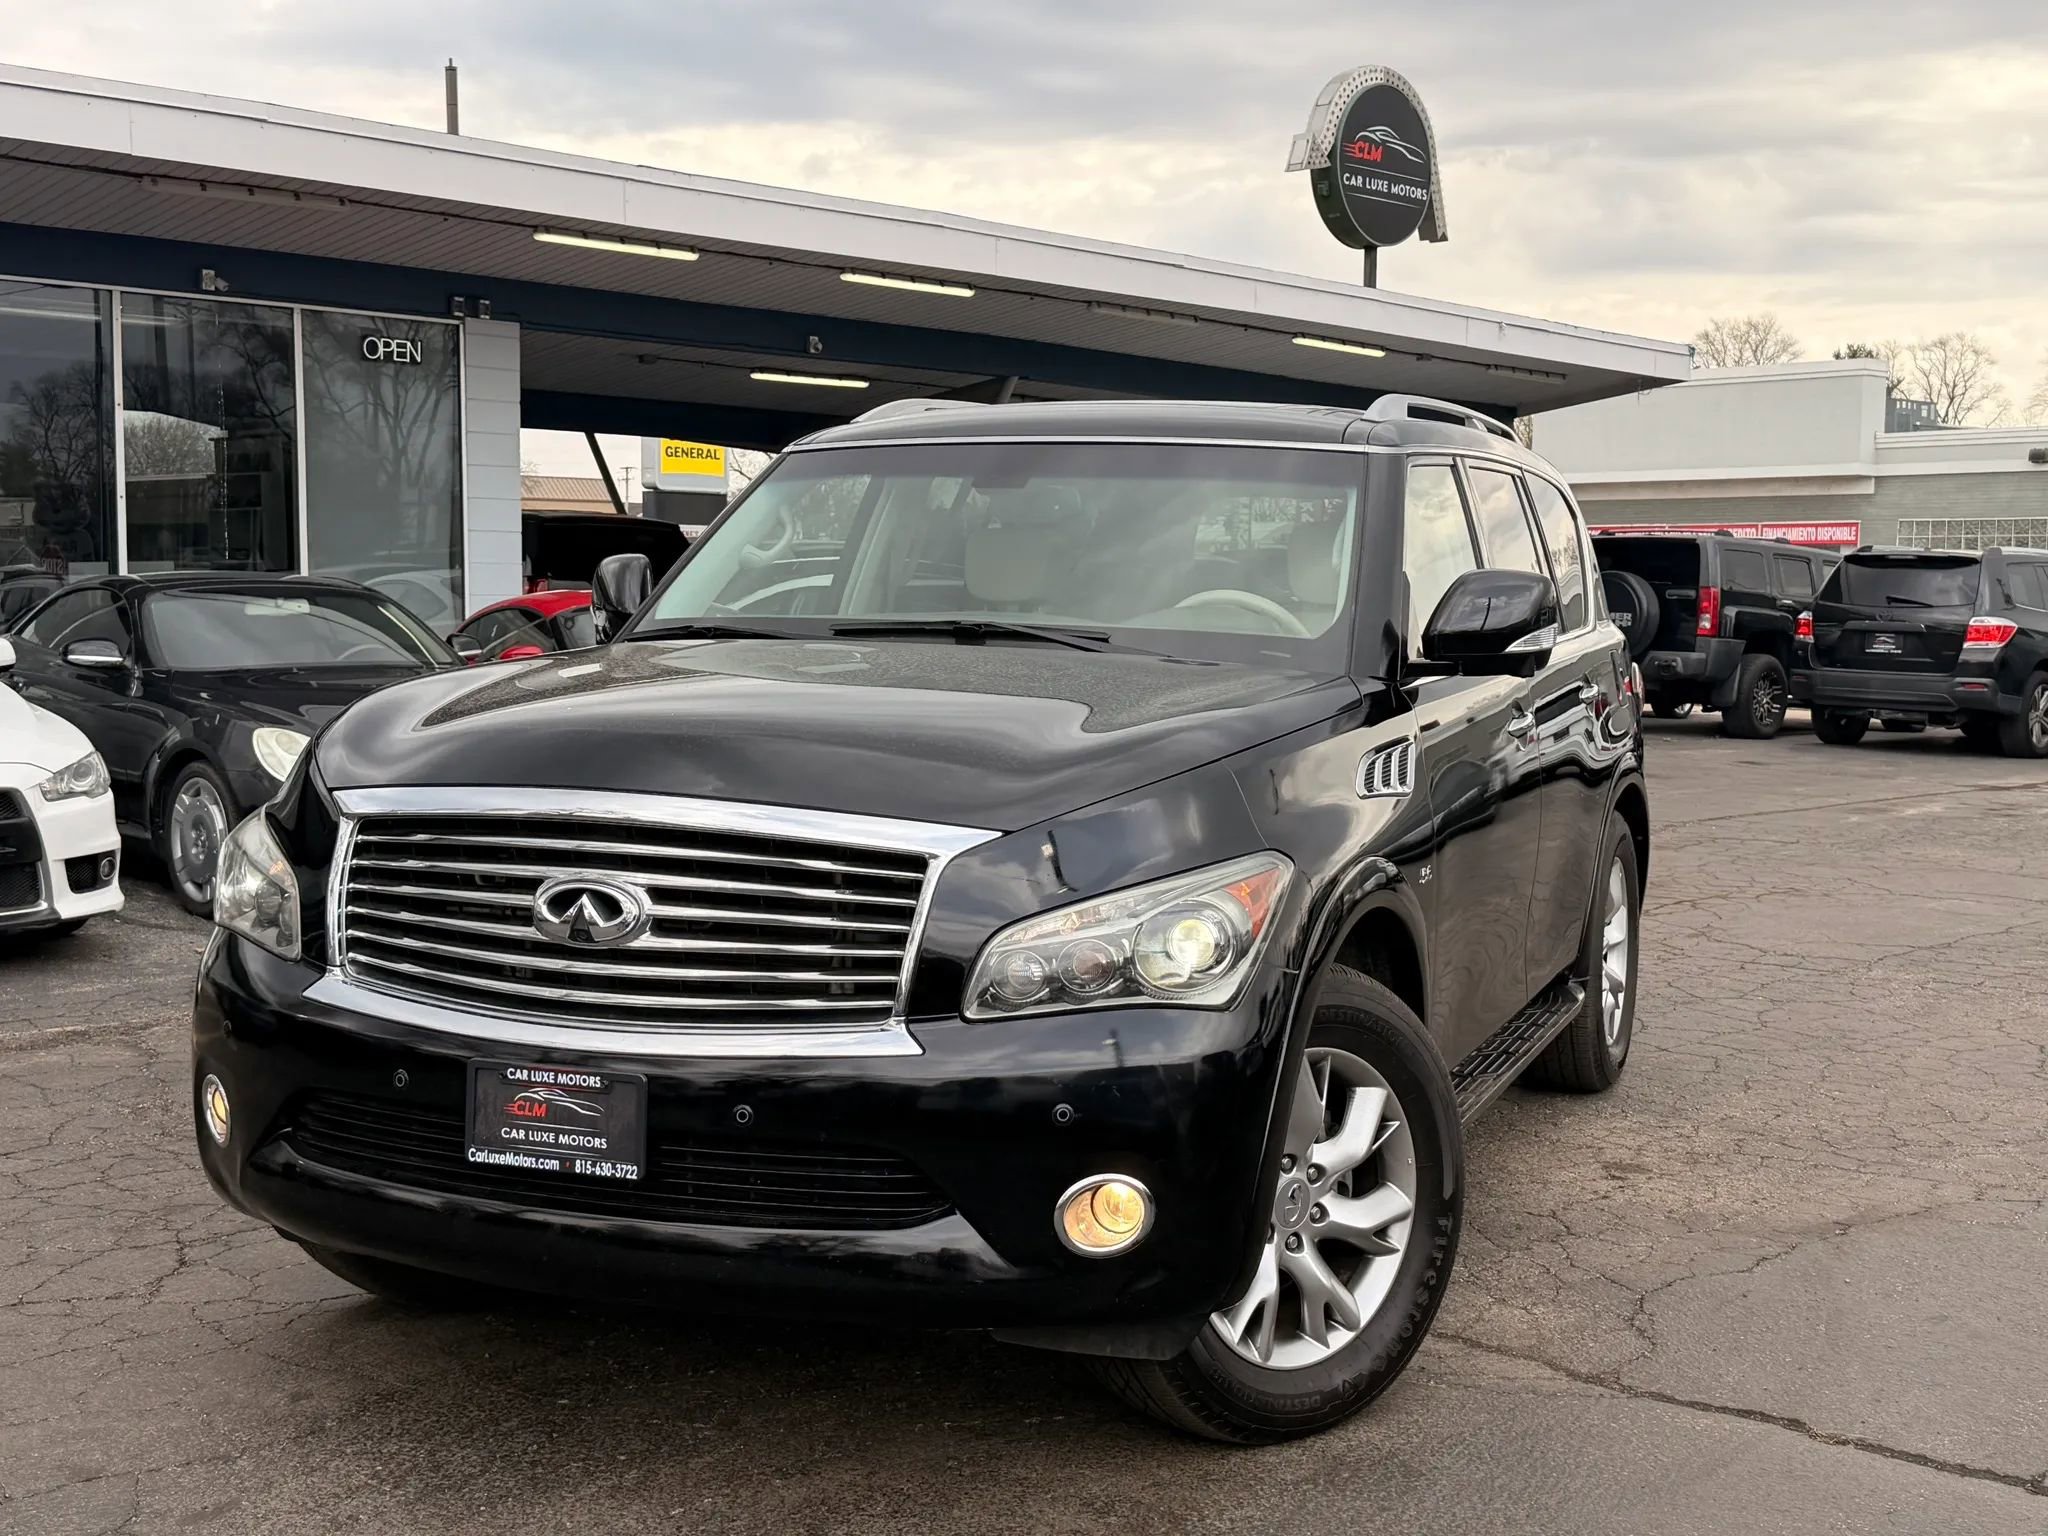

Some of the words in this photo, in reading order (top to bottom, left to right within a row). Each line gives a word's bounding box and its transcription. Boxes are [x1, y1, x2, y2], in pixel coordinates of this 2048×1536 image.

[1354, 140, 1383, 162] CLM
[1343, 172, 1363, 188] CAR
[1366, 177, 1389, 193] LUXE
[1391, 183, 1428, 201] MOTORS
[363, 336, 421, 363] OPEN
[665, 445, 721, 460] GENERAL
[1817, 526, 1857, 541] DISPONIBLE
[506, 1067, 529, 1081] CAR
[530, 1069, 555, 1084] LUXE
[557, 1073, 601, 1088] MOTORS
[513, 1099, 548, 1117] CLM
[501, 1127, 526, 1140] CAR
[529, 1130, 556, 1144] LUXE
[558, 1133, 608, 1150] MOTORS
[468, 1148, 560, 1171] CarLuxeMotors.com
[575, 1159, 638, 1180] 815-630-3722
